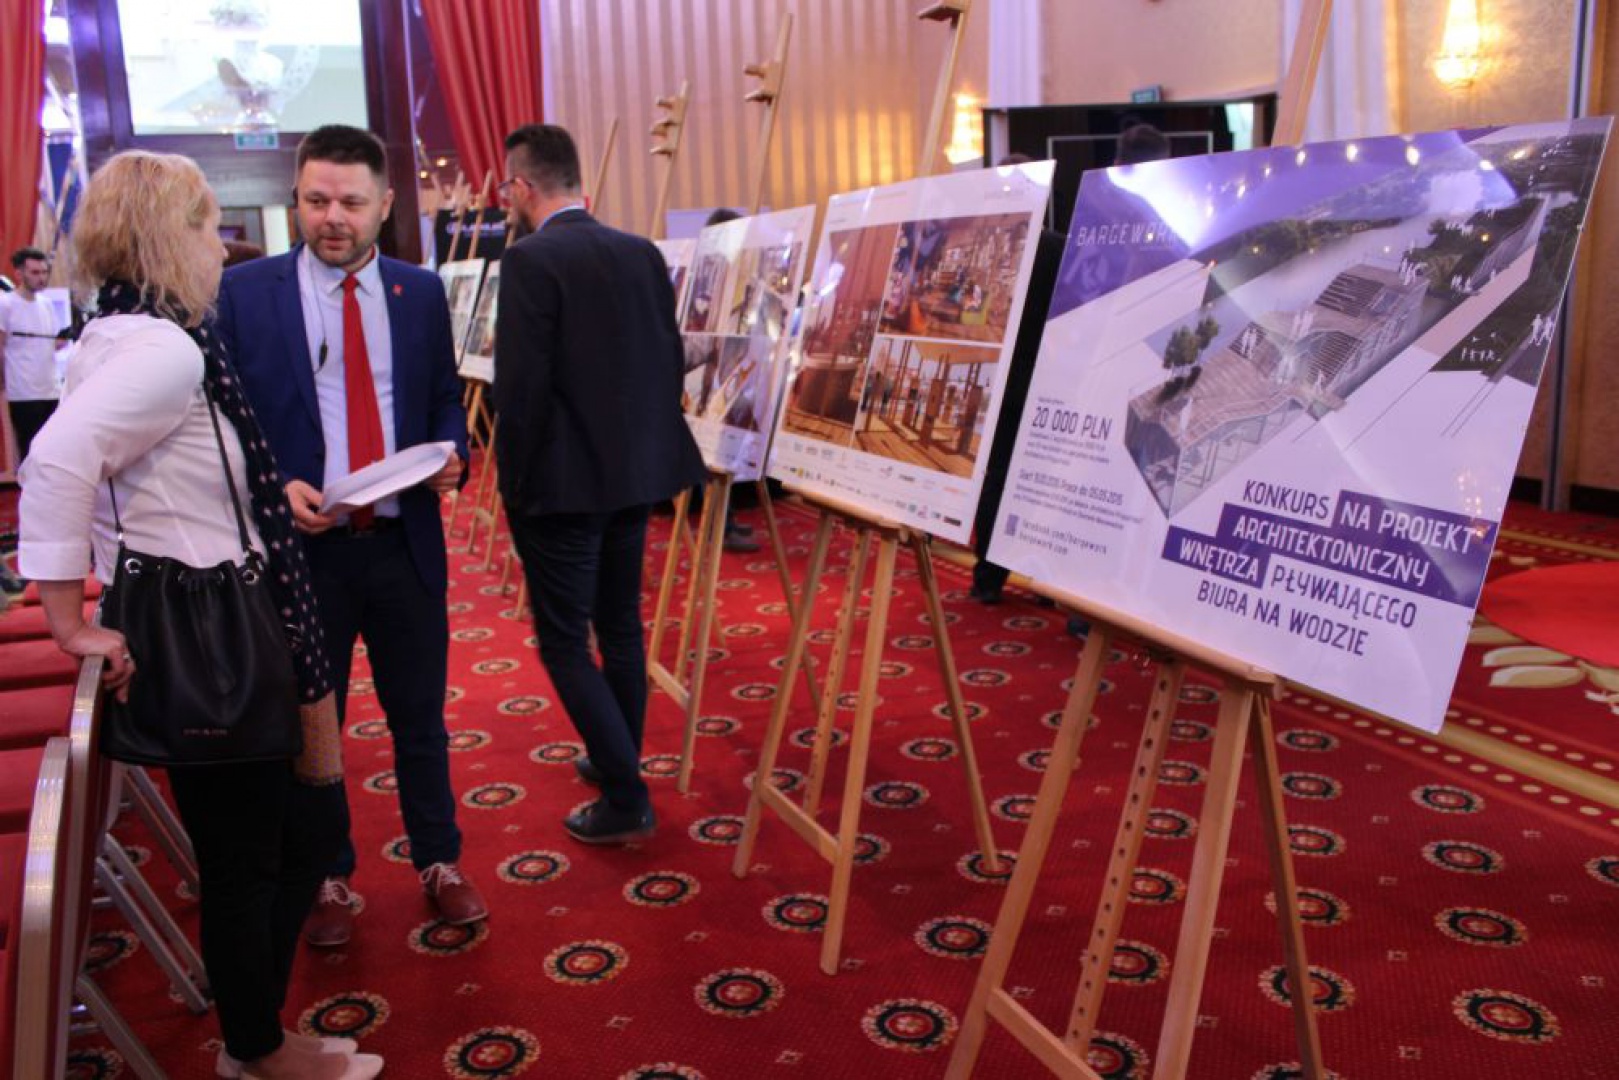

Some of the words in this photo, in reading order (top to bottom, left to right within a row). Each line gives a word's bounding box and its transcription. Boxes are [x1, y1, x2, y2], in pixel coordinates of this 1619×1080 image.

[1031, 405, 1050, 428] 20
[1051, 409, 1080, 434] 000
[1081, 414, 1113, 441] PLN
[1232, 514, 1431, 587] ARCHITEKTONICZNY
[1242, 479, 1330, 519] KONKURS
[1339, 504, 1371, 531] NA
[1378, 509, 1476, 555] PROJEKT
[1178, 536, 1259, 582] WNĘTRZA
[1270, 564, 1418, 629] PŁYWAJĄCEGO
[1196, 579, 1249, 617] BIURA
[1253, 597, 1281, 627] NA
[1288, 607, 1369, 656] WODZIE
